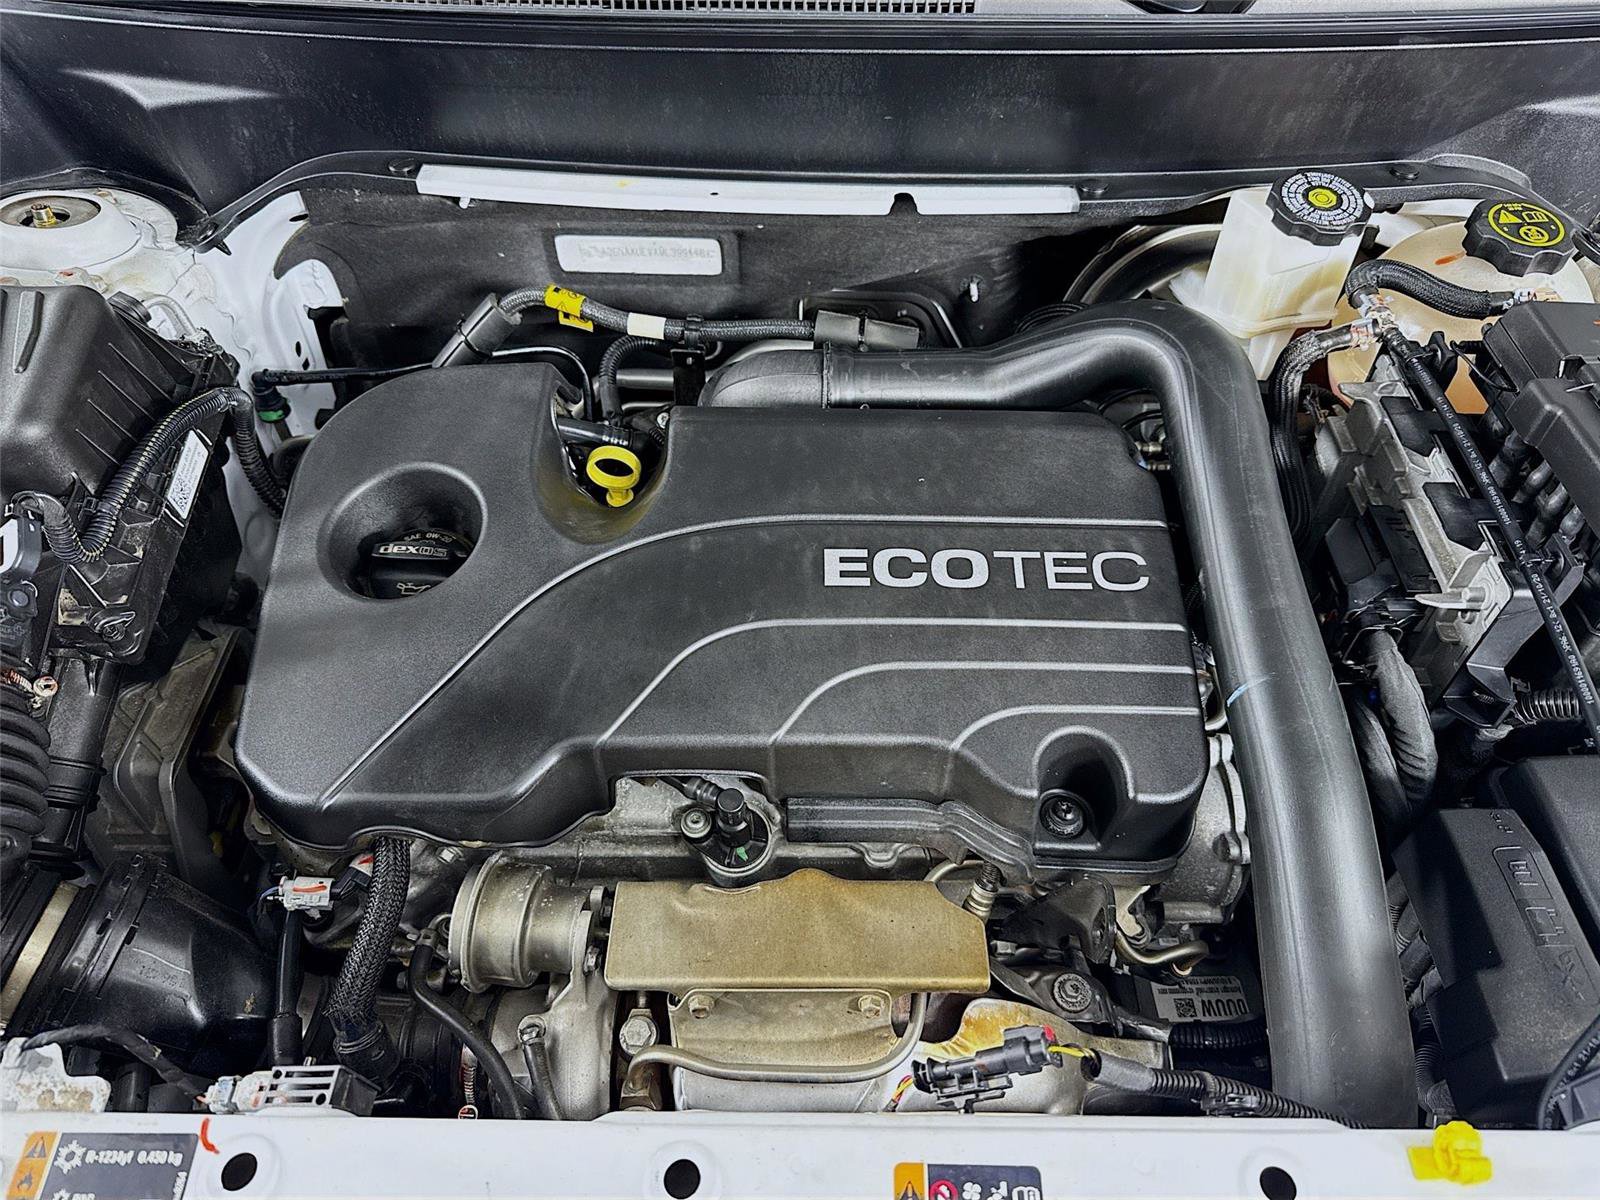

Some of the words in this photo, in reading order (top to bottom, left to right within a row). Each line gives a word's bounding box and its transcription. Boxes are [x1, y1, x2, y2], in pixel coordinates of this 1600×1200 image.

[404, 532, 421, 542] SAE
[823, 548, 1150, 592] ECOTEC
[168, 1149, 183, 1167] kg
